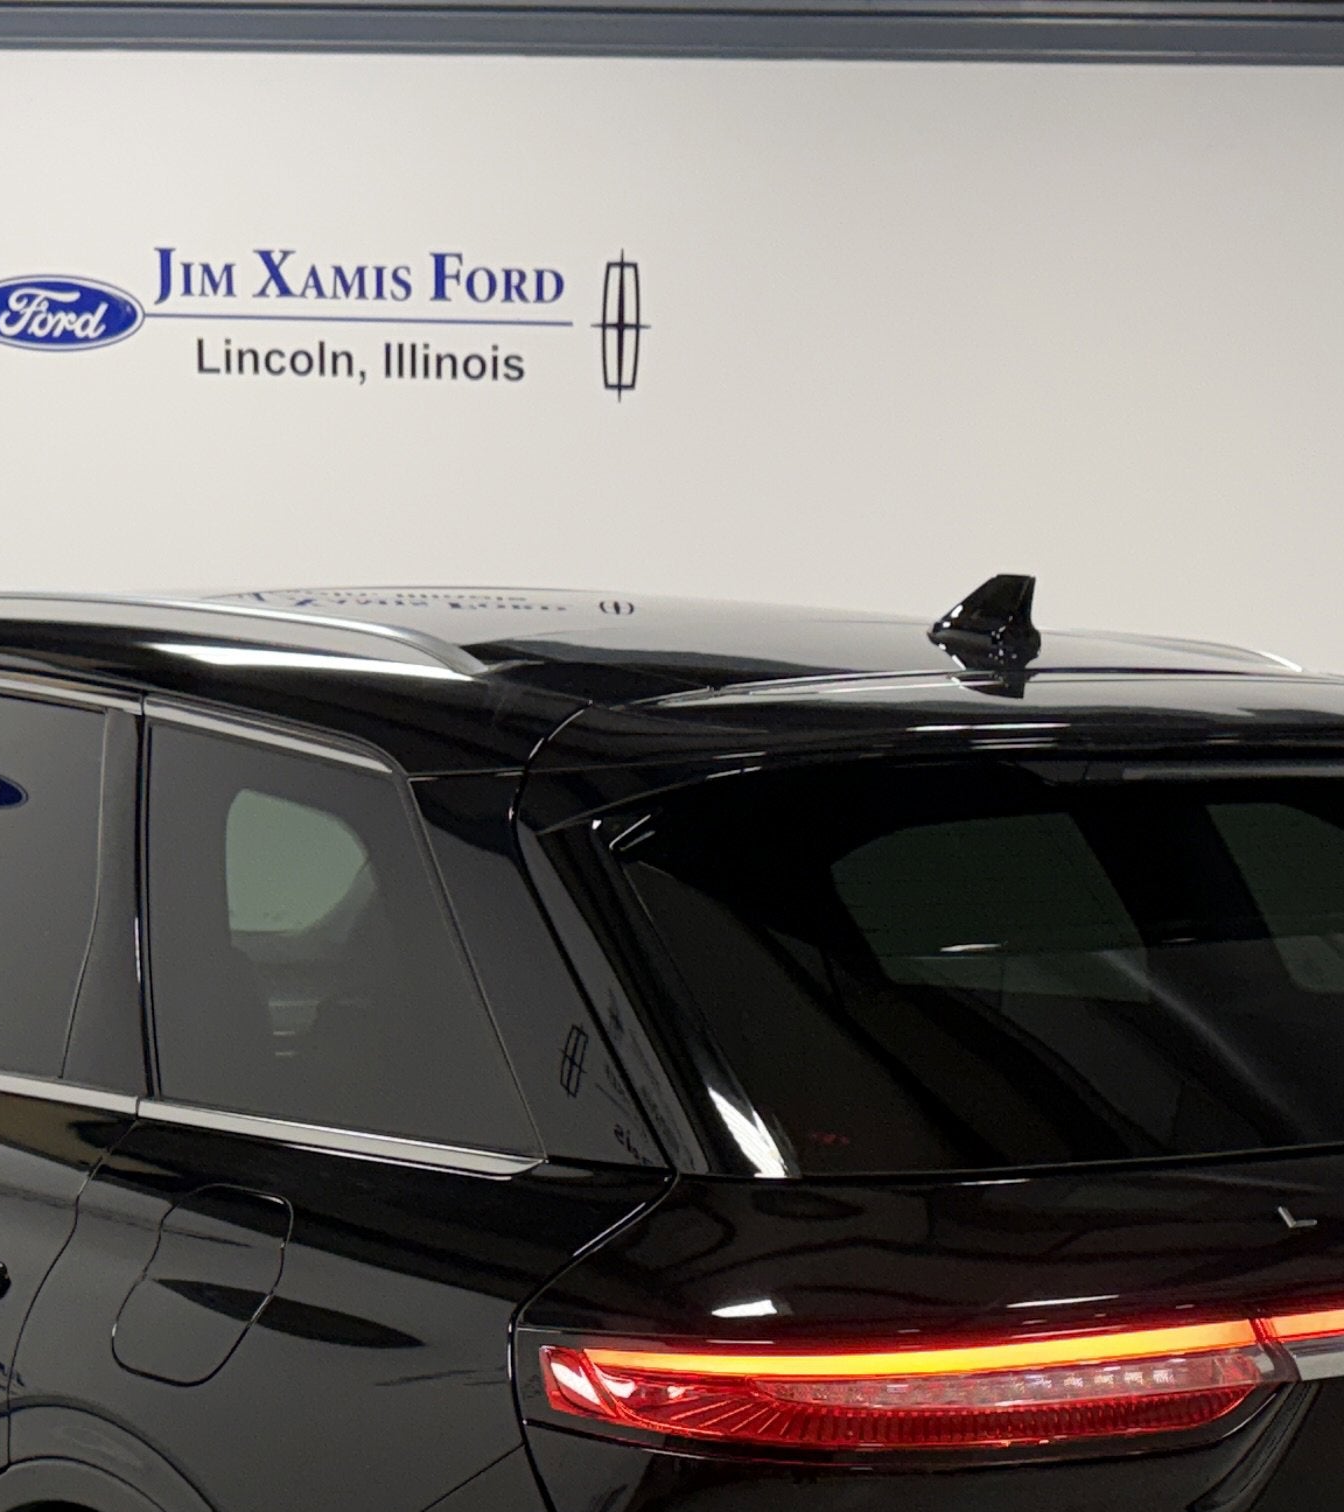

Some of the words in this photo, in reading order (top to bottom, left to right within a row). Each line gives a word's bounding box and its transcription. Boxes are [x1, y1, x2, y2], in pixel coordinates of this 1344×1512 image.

[154, 247, 237, 305] JIM
[253, 249, 413, 302] XAMIS
[429, 252, 566, 304] FORD
[197, 338, 368, 385] Lincoln,
[384, 342, 526, 382] Illinois
